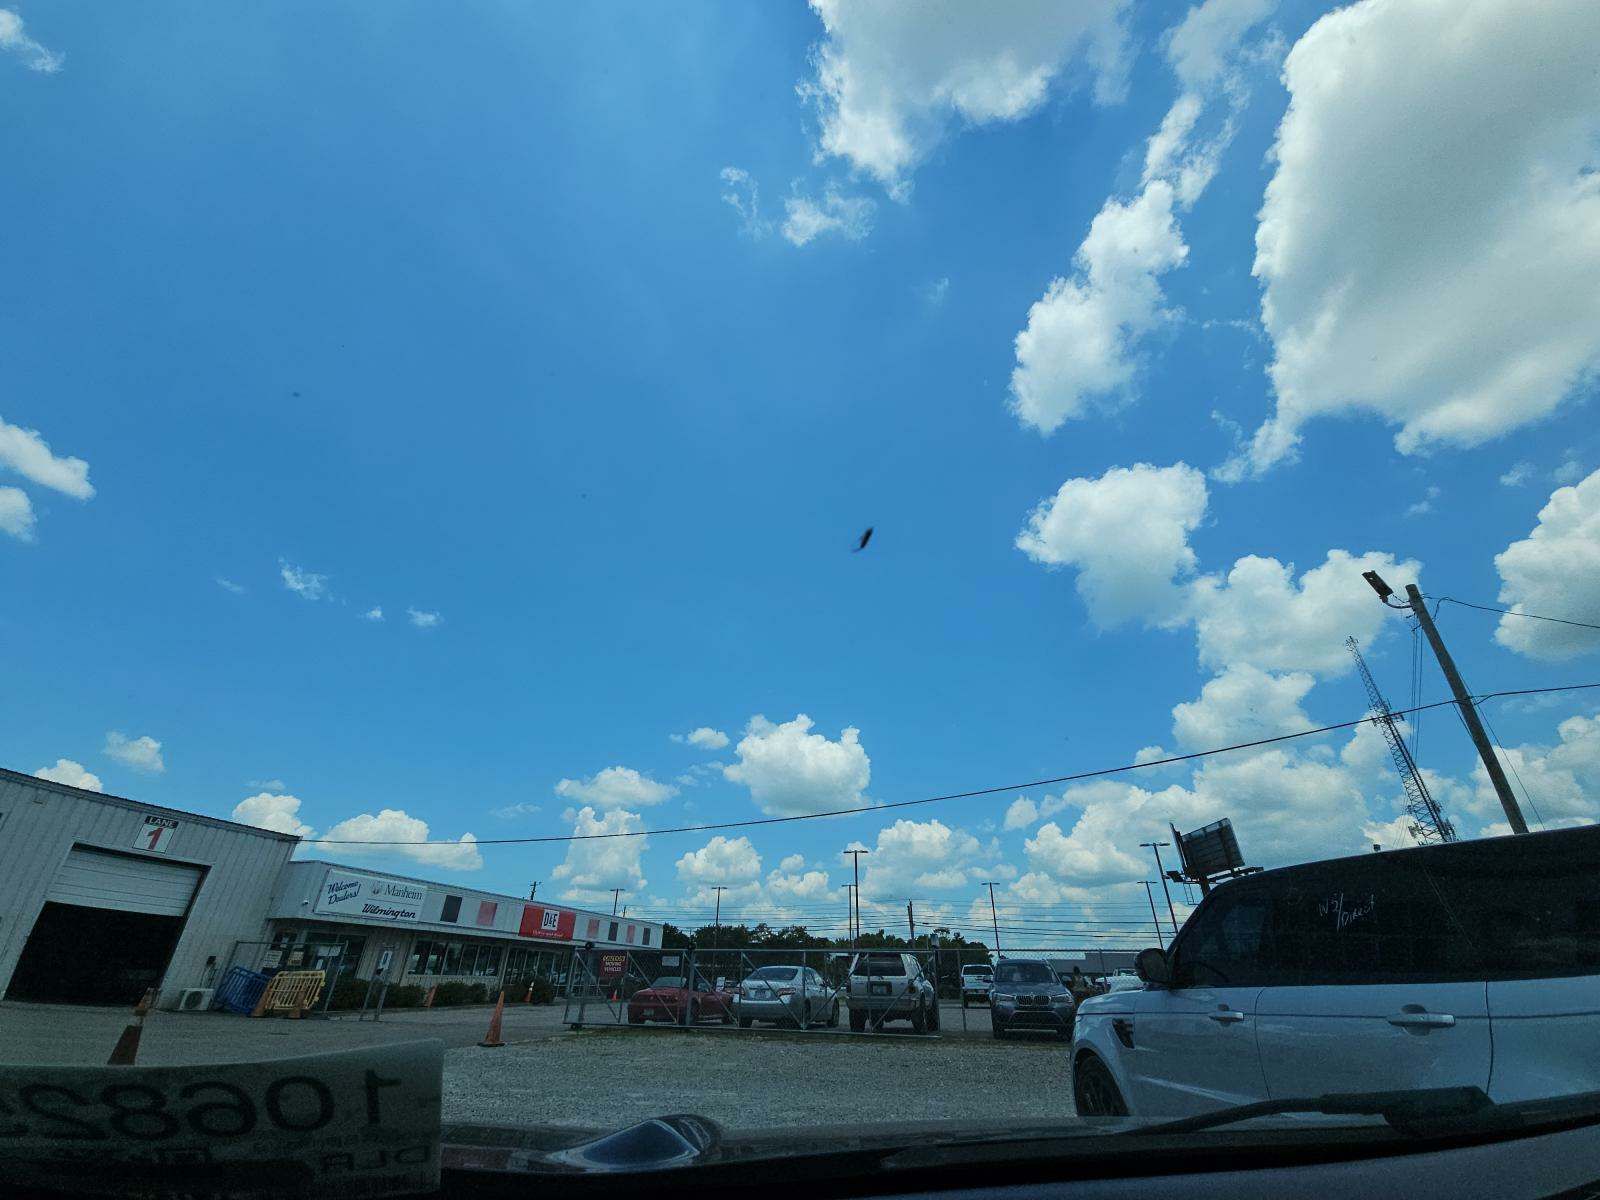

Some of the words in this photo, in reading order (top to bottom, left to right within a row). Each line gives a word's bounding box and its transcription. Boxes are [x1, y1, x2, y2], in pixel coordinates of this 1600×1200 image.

[149, 817, 176, 827] LANE
[147, 827, 164, 850] 1
[327, 881, 359, 894] Welcome
[384, 884, 423, 900] Manheim
[362, 903, 416, 920] Wilmington
